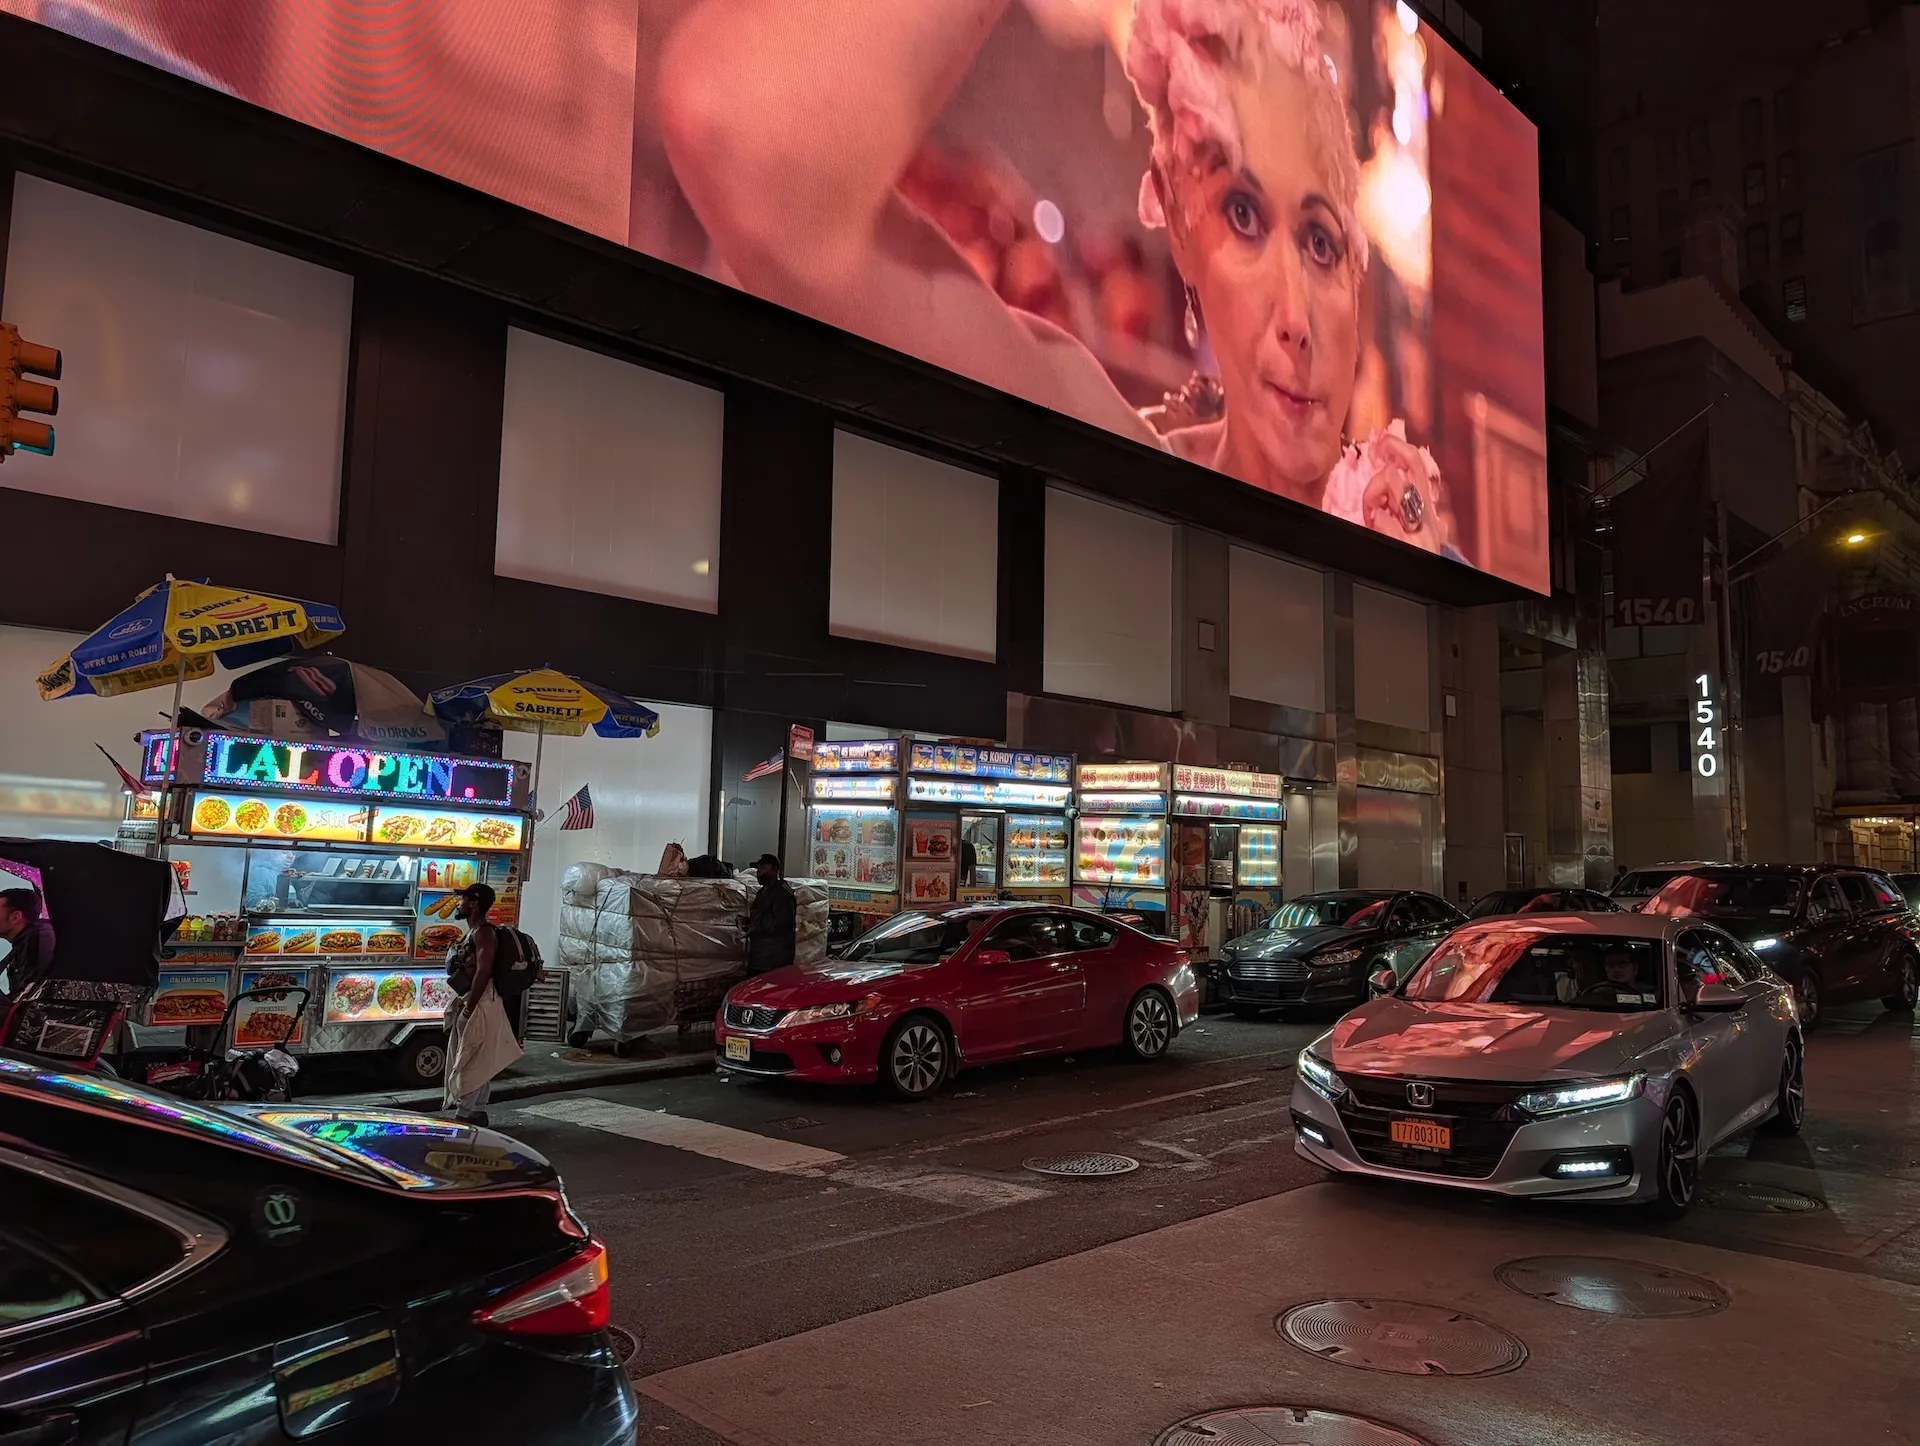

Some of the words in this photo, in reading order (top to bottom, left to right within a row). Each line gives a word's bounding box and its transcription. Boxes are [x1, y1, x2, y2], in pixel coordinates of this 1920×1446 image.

[1619, 597, 1695, 625] 1540
[1838, 596, 1913, 618] LYCEUM
[177, 610, 298, 648] SABRETT
[107, 653, 120, 664] ON
[298, 699, 326, 721] OGS
[515, 702, 583, 717] SABRETT
[387, 726, 427, 739] DRINKS
[1695, 674, 1716, 778] 1540
[979, 751, 988, 762] 45
[989, 751, 1014, 764] KORDY
[1081, 769, 1097, 785] 45
[1177, 768, 1192, 790] 45
[1420, 1118, 1437, 1126] YORK
[1395, 1123, 1446, 1145] T778031C
